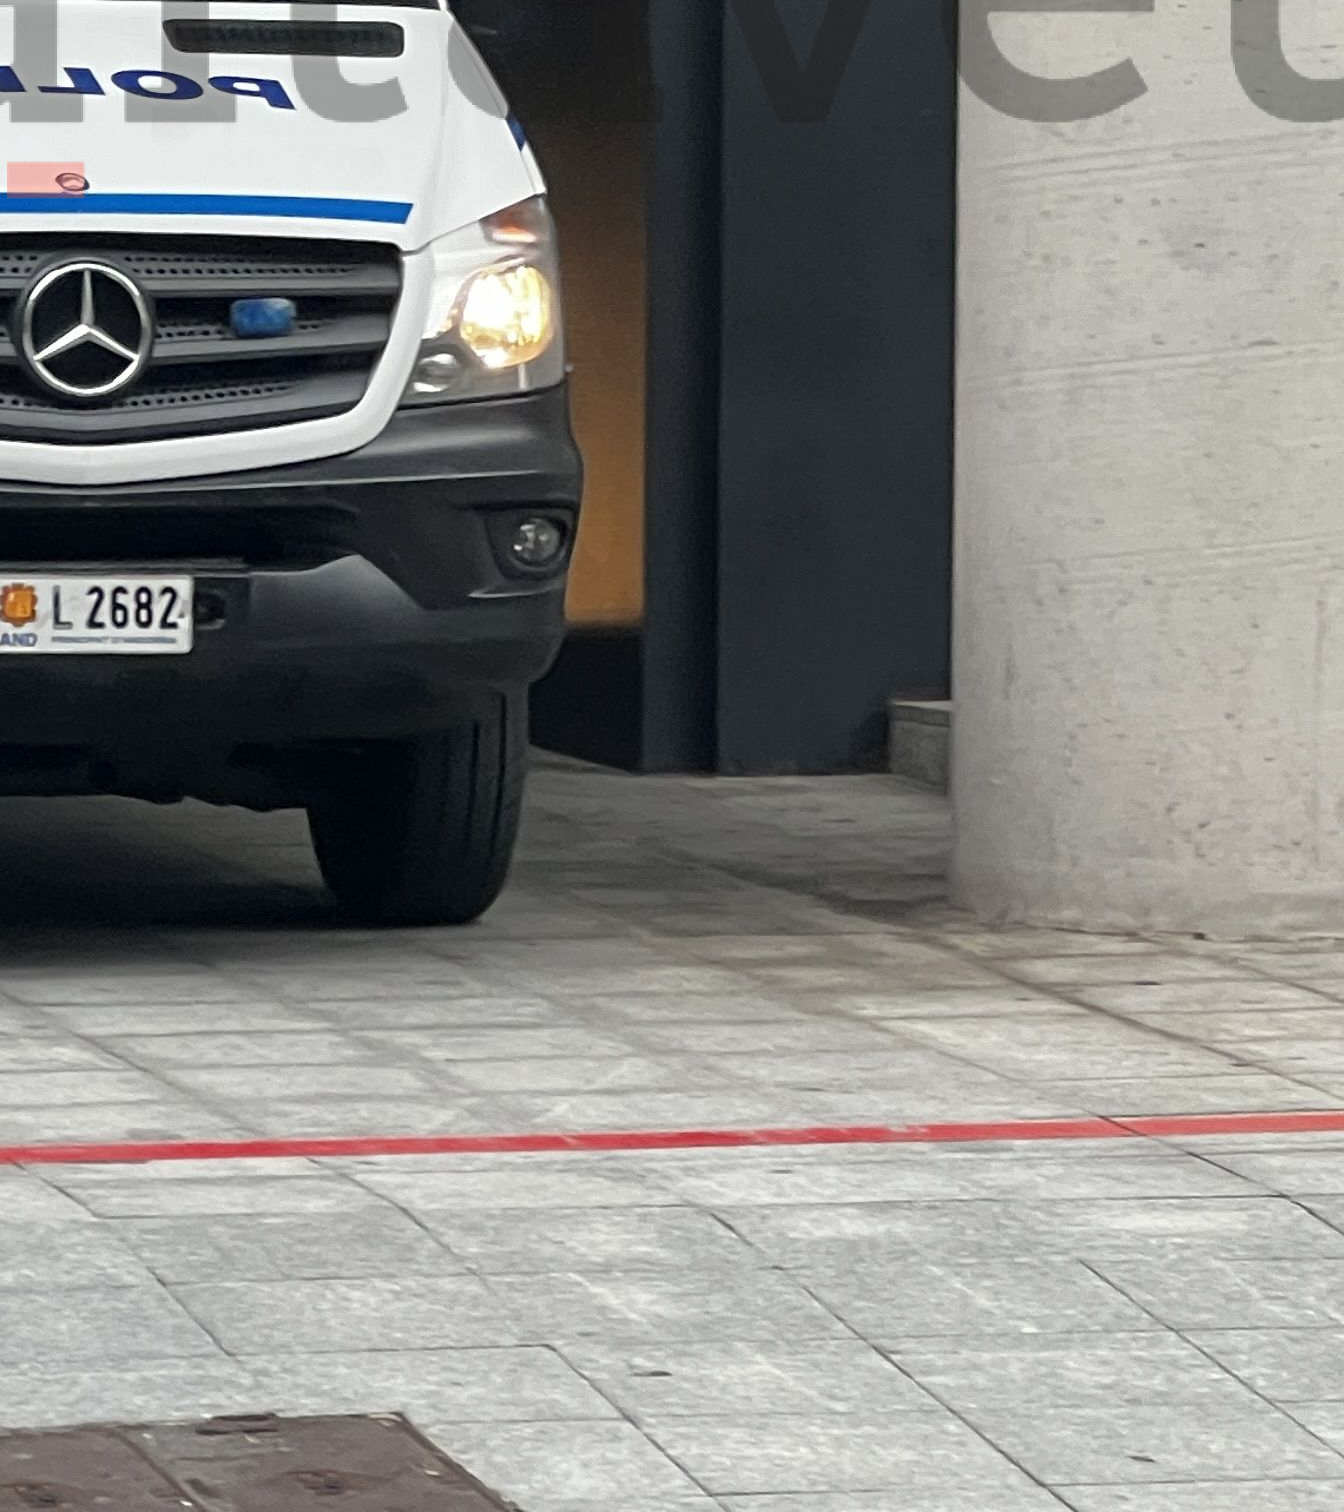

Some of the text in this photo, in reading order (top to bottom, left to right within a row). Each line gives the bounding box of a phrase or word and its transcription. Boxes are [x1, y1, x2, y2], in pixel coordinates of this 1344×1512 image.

[52, 585, 179, 630] L 2682
[0, 633, 38, 647] AND
